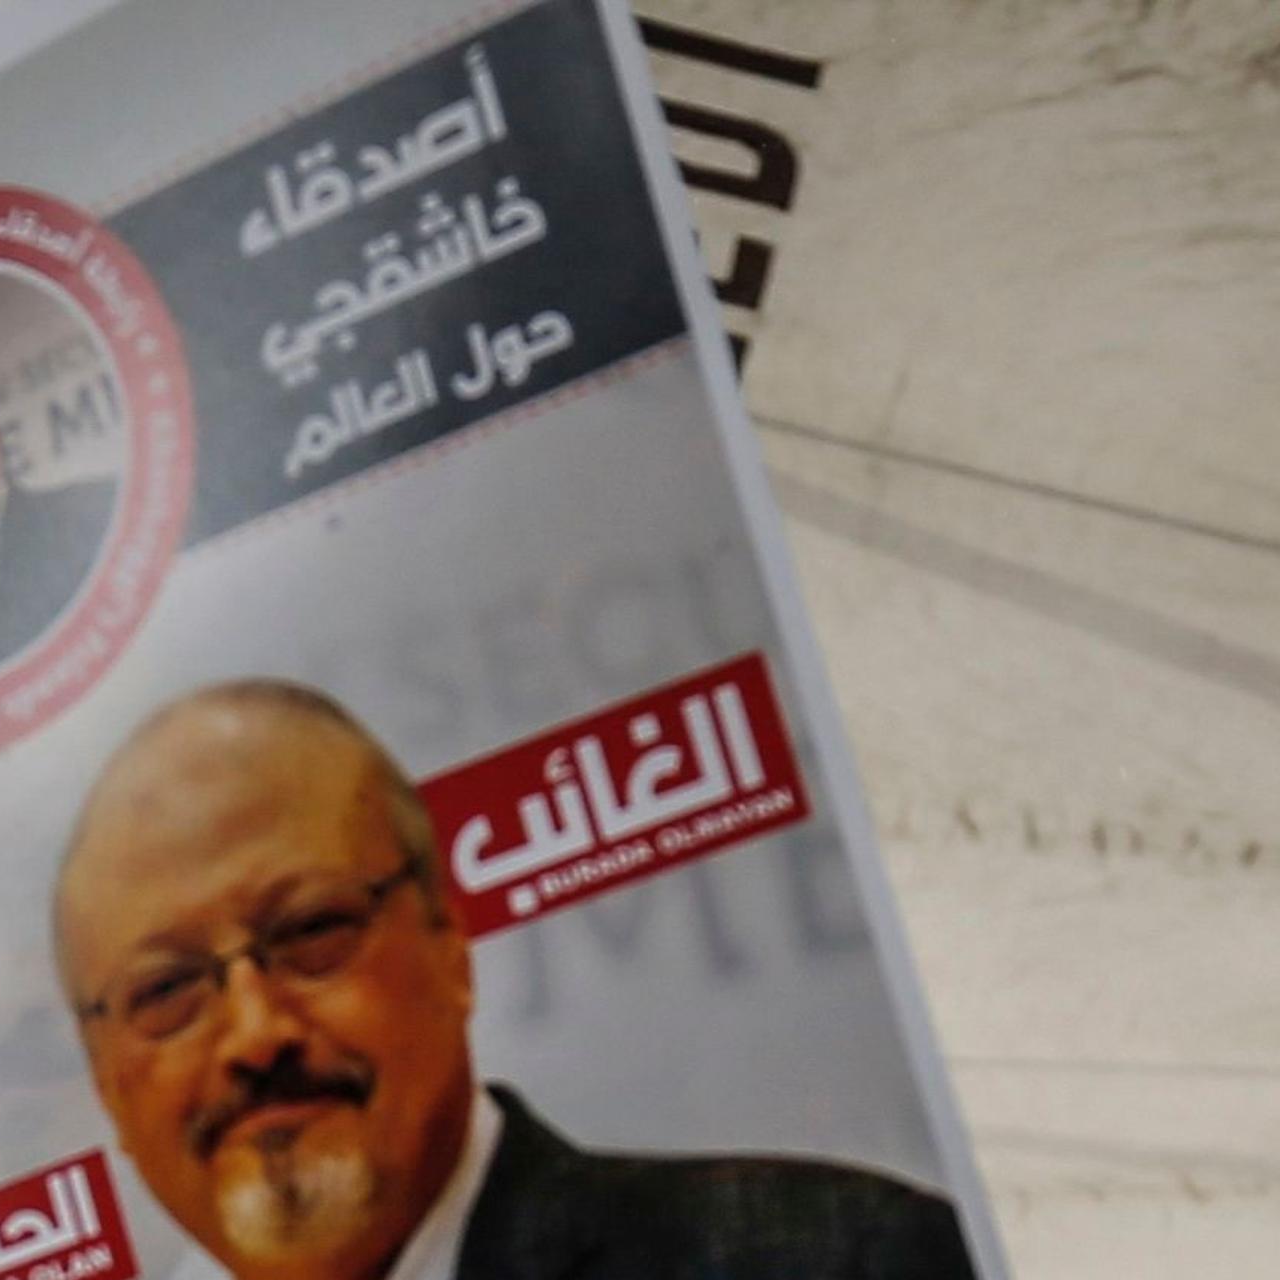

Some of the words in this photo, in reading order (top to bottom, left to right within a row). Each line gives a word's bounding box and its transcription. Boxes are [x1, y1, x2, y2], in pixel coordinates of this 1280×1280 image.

[238, 42, 509, 260] أصدقاء
[260, 176, 549, 389] خاشقجي
[450, 309, 574, 404] حول
[283, 348, 441, 479] العالم
[451, 681, 768, 918] الغائب
